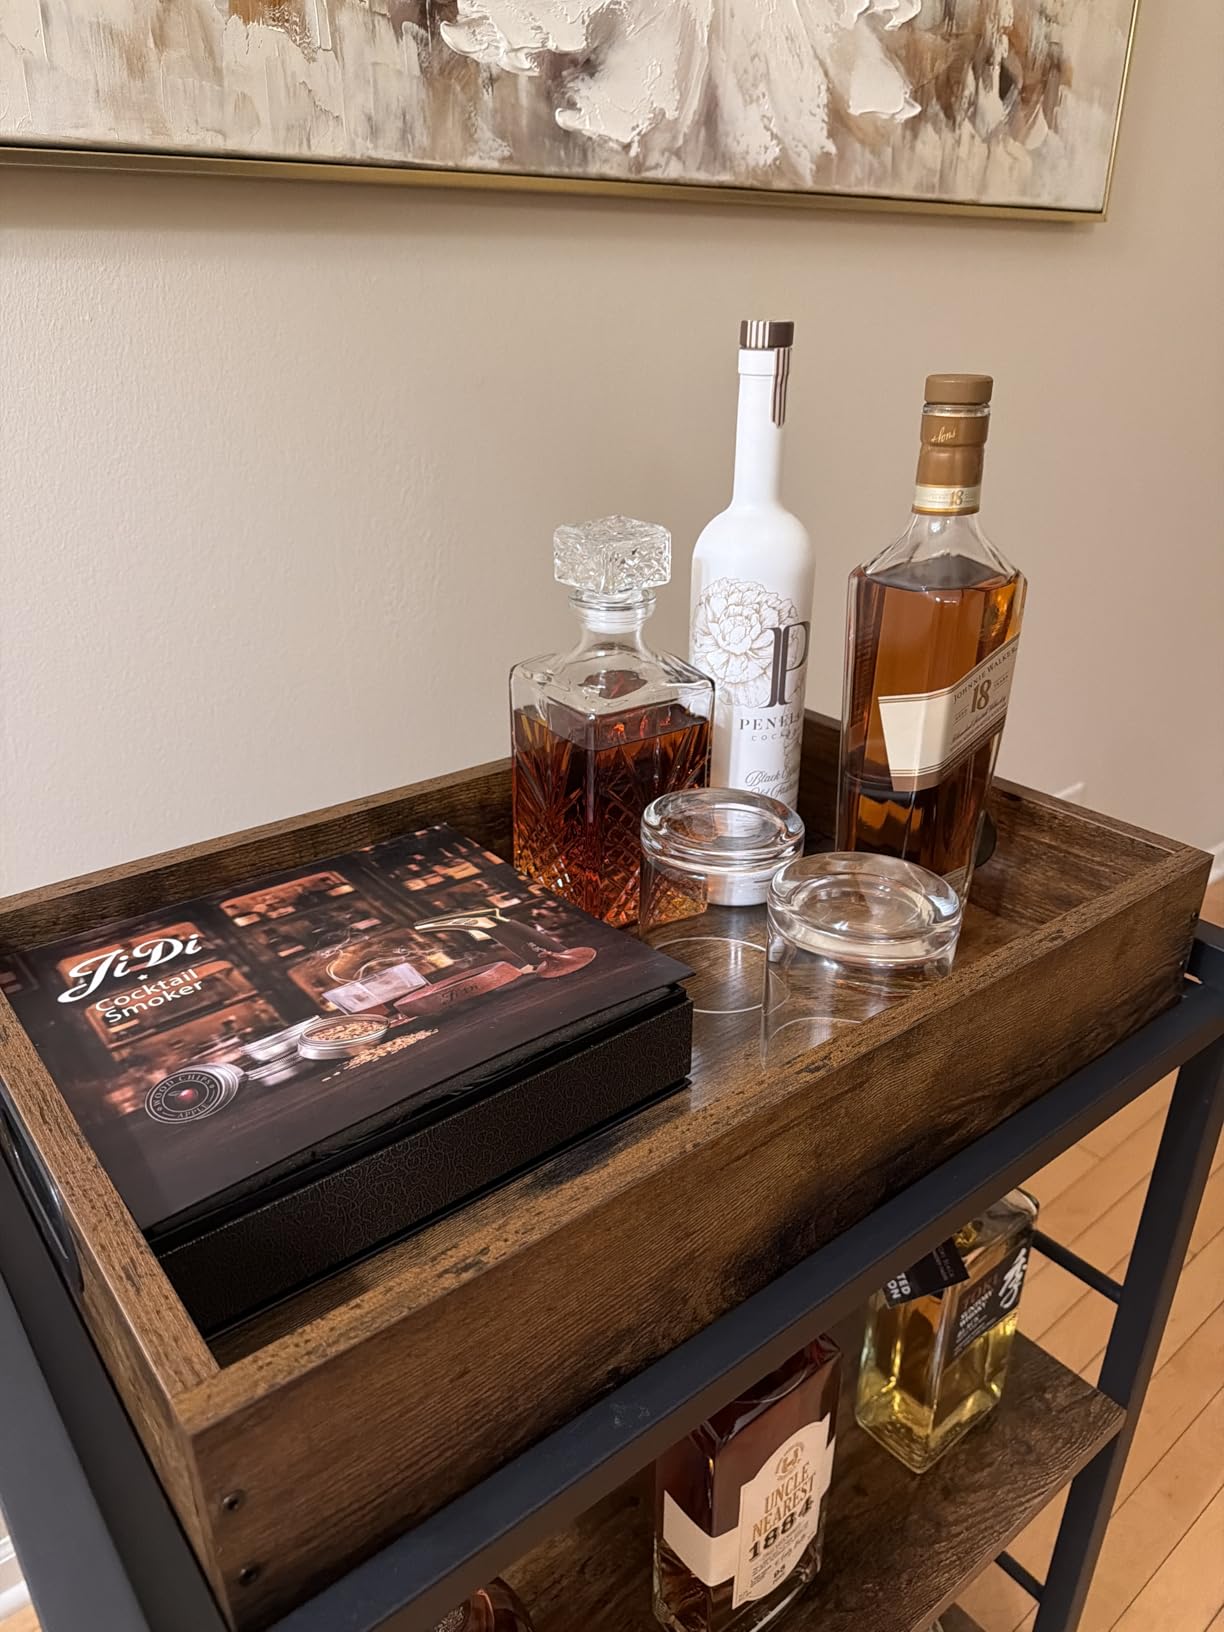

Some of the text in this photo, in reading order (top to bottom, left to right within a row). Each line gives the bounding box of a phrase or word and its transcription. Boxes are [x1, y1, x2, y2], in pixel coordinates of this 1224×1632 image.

[757, 621, 811, 709] P
[953, 670, 986, 704] JOHNNIE
[970, 679, 992, 712] 18
[57, 933, 203, 1003] JiDi
[95, 968, 198, 1012] Cocktail
[104, 980, 203, 1023] Smoker
[153, 1073, 212, 1107] WOOD CHIPS
[751, 1471, 817, 1543] NEAREST
[764, 1461, 810, 1514] UNCLE
[748, 1494, 815, 1562] 1884
